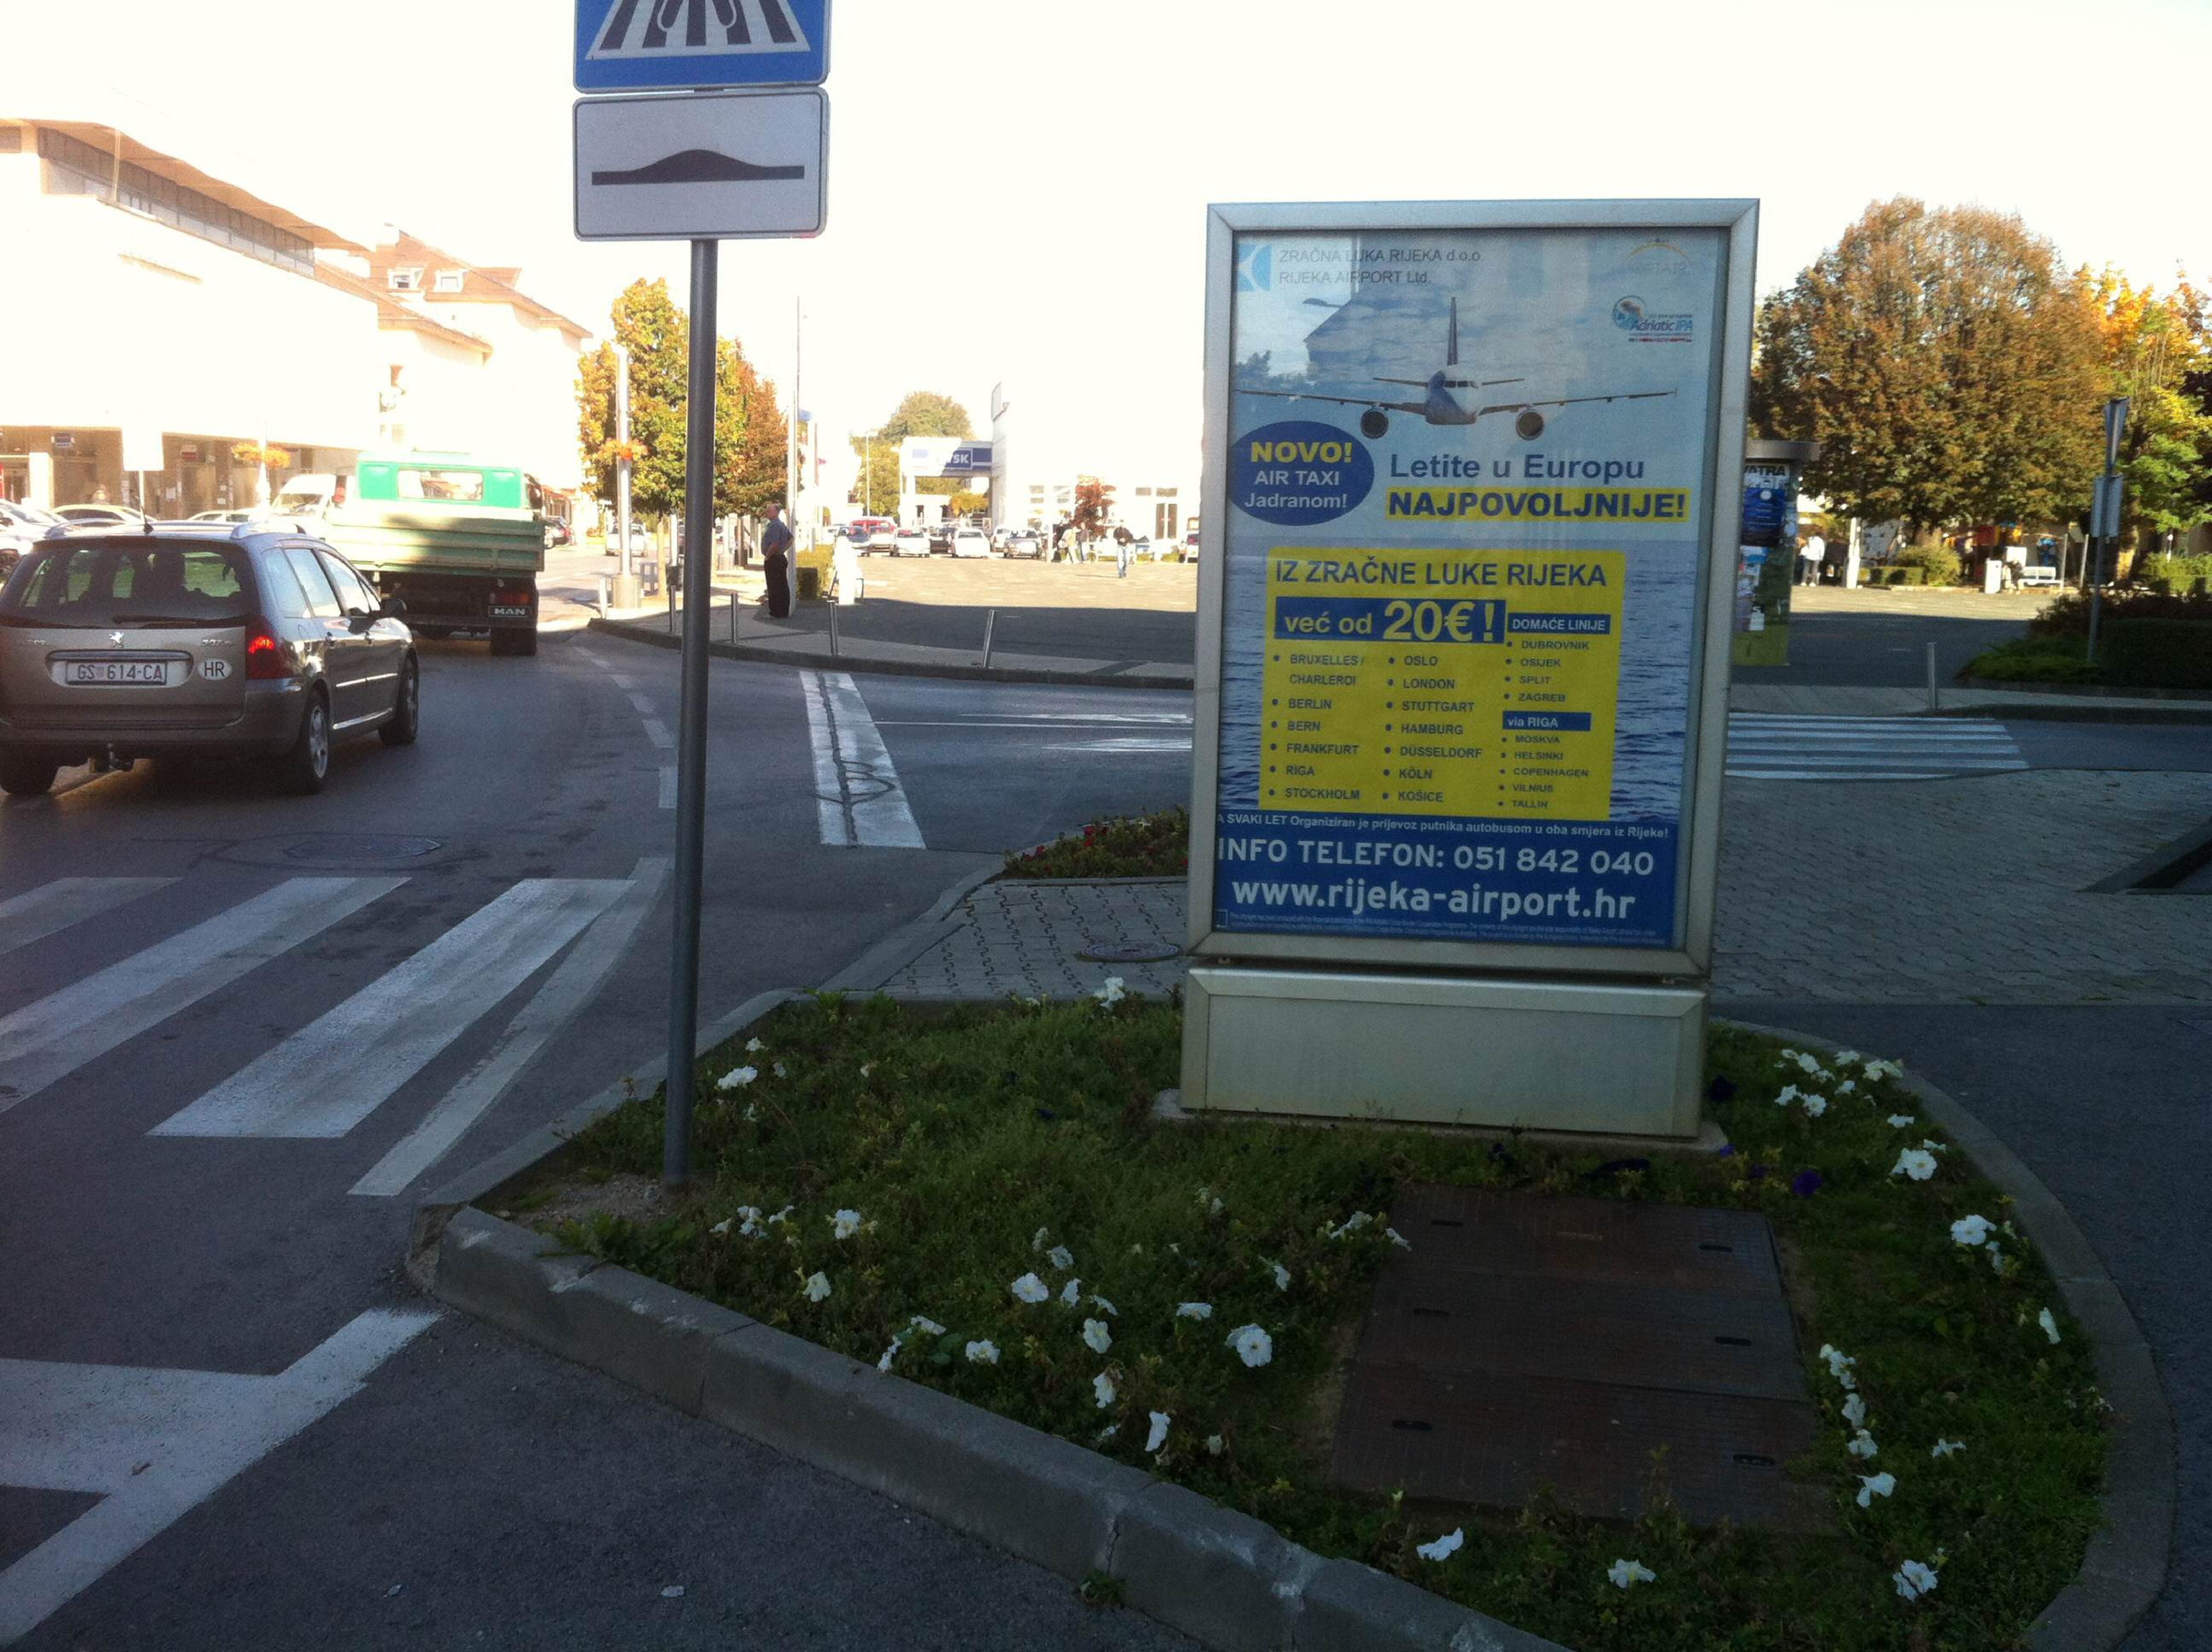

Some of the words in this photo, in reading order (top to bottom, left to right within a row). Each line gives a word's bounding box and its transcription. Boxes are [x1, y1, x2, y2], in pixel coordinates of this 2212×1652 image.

[1280, 247, 1341, 263] ZRAČNA
[1346, 249, 1385, 262] LUKA
[1390, 249, 1442, 262] RIJEKA
[1280, 272, 1332, 283] RIJEKA
[1335, 271, 1402, 283] AIRPORT
[1251, 442, 1351, 463] NOVO!
[1391, 454, 1480, 478] Letite
[1493, 460, 1510, 478] u
[1524, 455, 1644, 484] Europu
[1254, 471, 1289, 485] AIR
[1295, 471, 1339, 485] TAXI
[1245, 493, 1347, 508] Jadranom!
[1389, 492, 1684, 517] NAJPOVOLJNIJE!
[1276, 560, 1298, 582] IZ
[1306, 556, 1415, 584] ZRAČNE
[1426, 563, 1497, 585] LUKE
[1507, 564, 1607, 587] RIJEKA
[1284, 612, 1330, 633] već
[1338, 613, 1372, 633] od
[1568, 620, 1605, 631] LINIJE
[1521, 641, 1589, 649] DUBROVNIK
[1290, 654, 1358, 666] BRUXELLES
[1404, 656, 1438, 666] OSLO
[1521, 658, 1561, 667] OSIJEK
[77, 665, 95, 679] GS
[107, 664, 162, 679] 614-CA
[204, 661, 225, 677] HR
[1290, 674, 1355, 686] CHARLEROI
[1403, 679, 1455, 689] LONDON
[1518, 693, 1566, 702] ZAGREB
[1289, 699, 1332, 709] BERLIN
[1402, 701, 1474, 712] STUTTGART
[1288, 721, 1320, 731] BERN
[1401, 724, 1463, 734] HAMBURG
[1507, 718, 1524, 727] via
[1528, 718, 1558, 728] RIGA
[1515, 736, 1560, 744] MOSKVA
[1287, 743, 1359, 754] FRANKFURT
[1515, 752, 1564, 760] HELSINKI
[1286, 766, 1315, 776] RIGA
[1399, 766, 1432, 779] KÖLN
[1514, 768, 1589, 777] COPENHAGEN
[1285, 788, 1360, 800] STOCKHOLM
[1227, 814, 1262, 824] SVAKI
[1266, 815, 1287, 825] LET
[1290, 816, 1355, 829] Organiziran
[1358, 818, 1369, 829] je
[1372, 819, 1417, 830] prijevoz
[1420, 820, 1463, 832] putnika
[1466, 823, 1531, 834] autobusom
[1535, 826, 1543, 834] u
[1546, 824, 1567, 835] oba
[1571, 826, 1611, 838] smjera
[1615, 827, 1624, 836] iz
[1627, 827, 1668, 840] Rijeke!
[1218, 838, 1287, 862] INFO
[1298, 841, 1444, 868] TELEFON:
[1454, 846, 1505, 870] 051
[1517, 848, 1578, 873] 842
[1590, 850, 1654, 875] 040
[1232, 878, 1636, 922] www.rijeka-airport.hr
